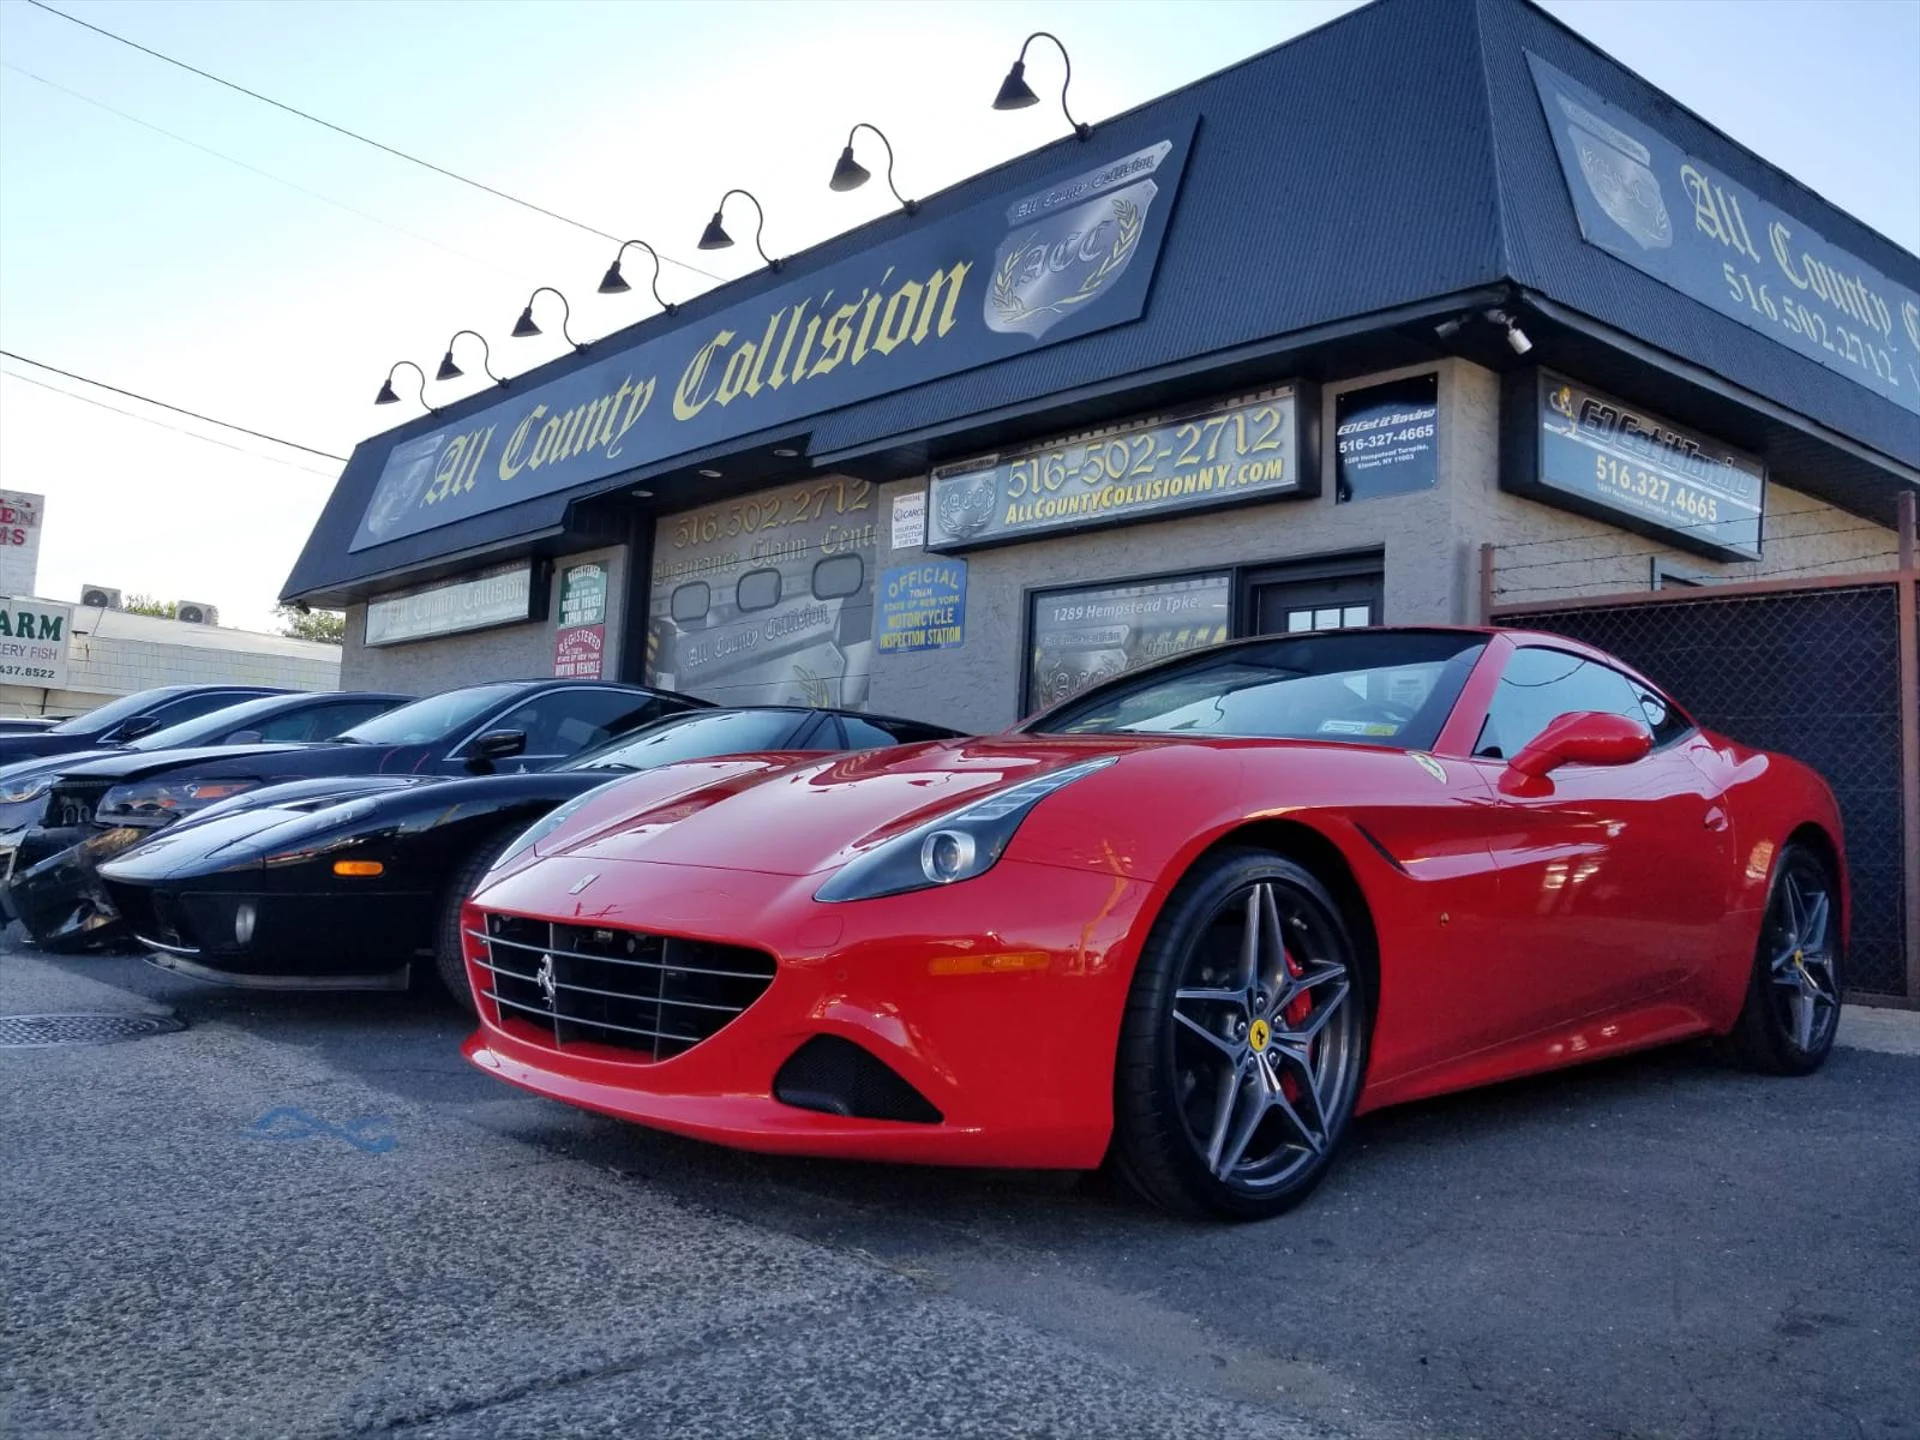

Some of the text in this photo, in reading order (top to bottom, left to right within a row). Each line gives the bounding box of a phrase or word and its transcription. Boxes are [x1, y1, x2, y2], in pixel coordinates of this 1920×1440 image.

[1680, 164, 1760, 264] All
[1770, 221, 1897, 352] County
[1723, 261, 1898, 387] 516.502.2712
[419, 260, 973, 508] All County Collision
[1007, 405, 1282, 499] 516-502-2712
[1339, 423, 1434, 454] 516-327-4665
[1596, 454, 1718, 522] 516.327.4665
[673, 479, 873, 550] 516.502.2712
[751, 536, 809, 568] Claim
[888, 567, 959, 599] OFFICIAL
[888, 606, 954, 629] MOTORCYCLE
[1053, 606, 1084, 622] 1289
[1086, 597, 1162, 619] Hempstead
[0, 610, 64, 642] ARM
[880, 625, 961, 650] INSPECTION STATION
[0, 643, 58, 661] ERY FISH
